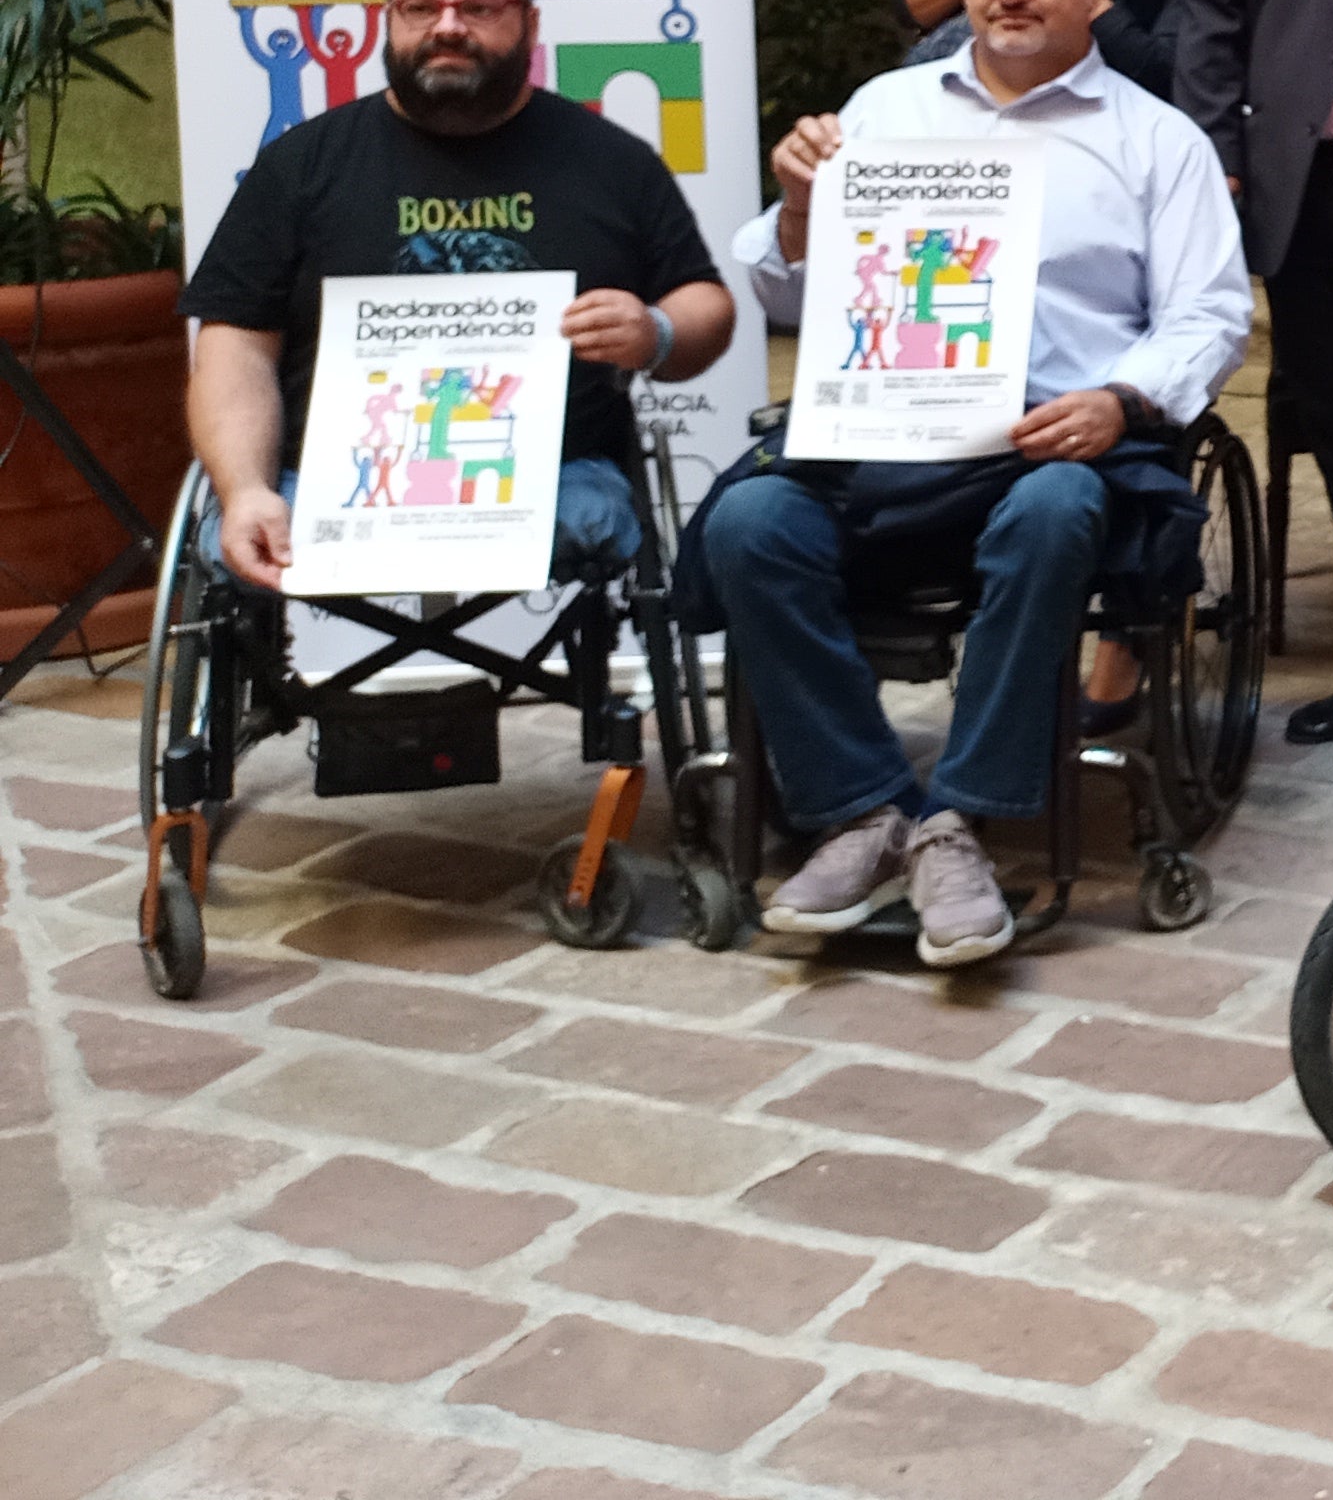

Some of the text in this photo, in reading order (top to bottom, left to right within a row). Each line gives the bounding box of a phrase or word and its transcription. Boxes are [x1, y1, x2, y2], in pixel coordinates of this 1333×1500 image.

[980, 160, 1012, 179] de
[397, 191, 535, 236] BOXING
[503, 297, 537, 316] de
